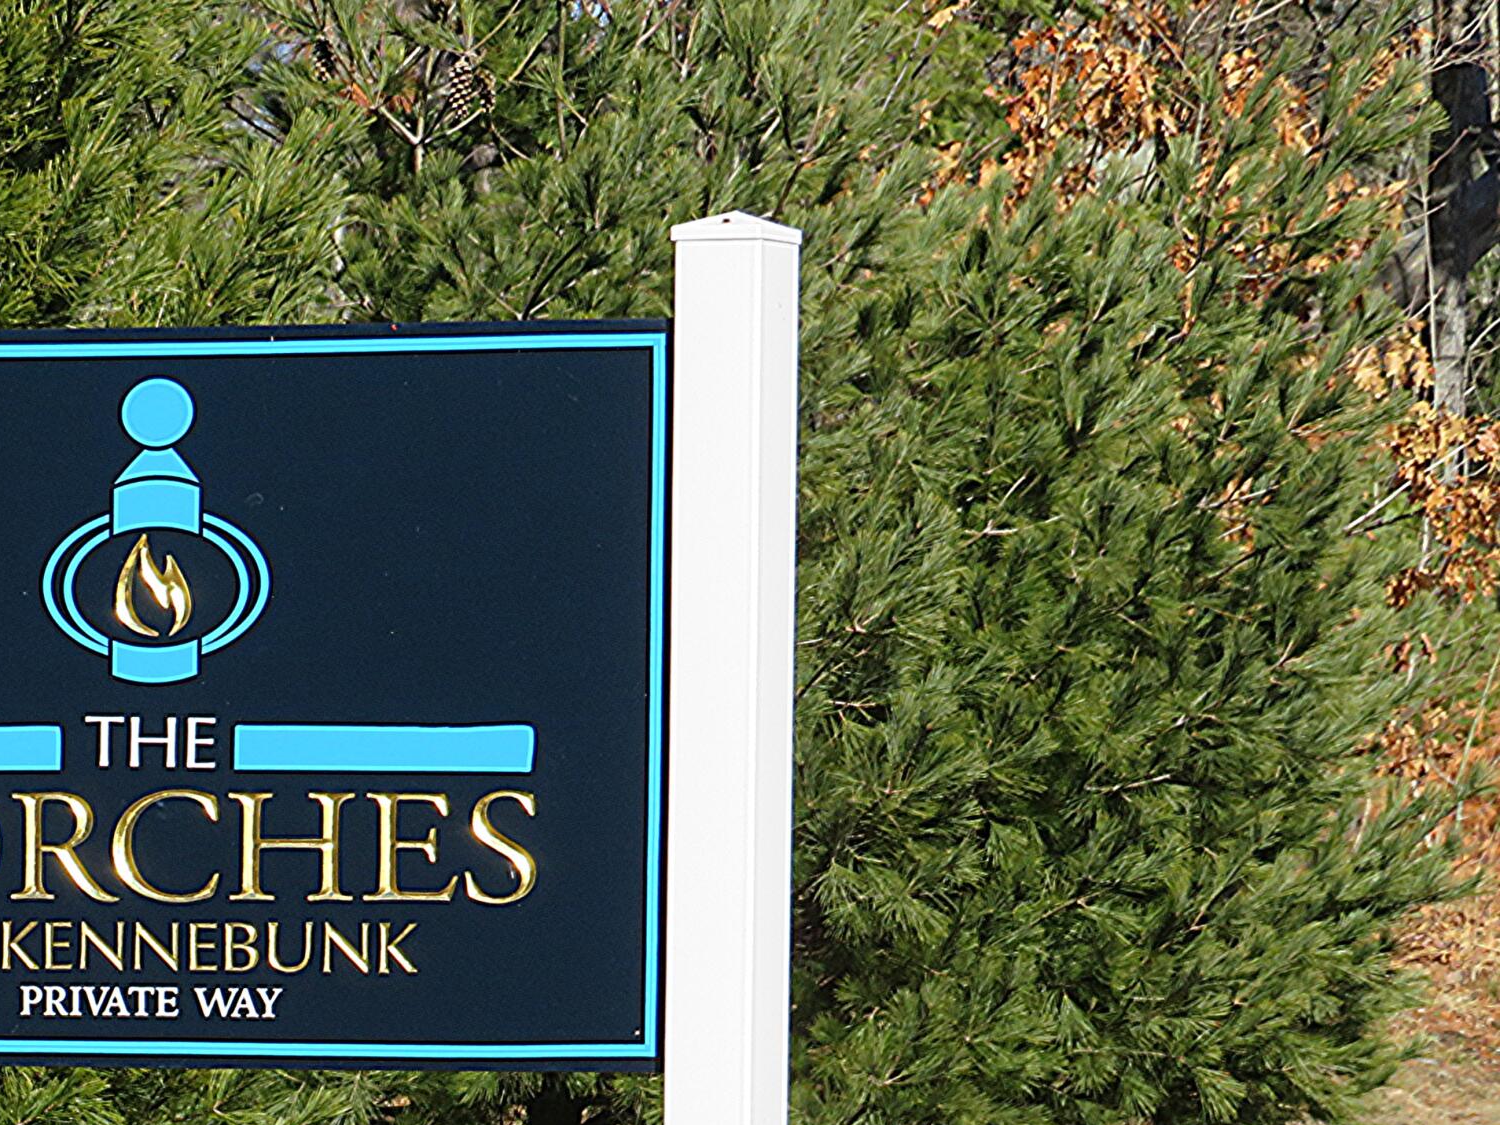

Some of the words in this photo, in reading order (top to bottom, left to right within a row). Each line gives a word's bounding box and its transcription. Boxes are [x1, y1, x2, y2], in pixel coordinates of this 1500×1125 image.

[84, 715, 217, 770] THE
[0, 920, 419, 975] KENNEBUNK
[19, 985, 180, 1018] PRIVATE
[194, 986, 284, 1019] WAY
